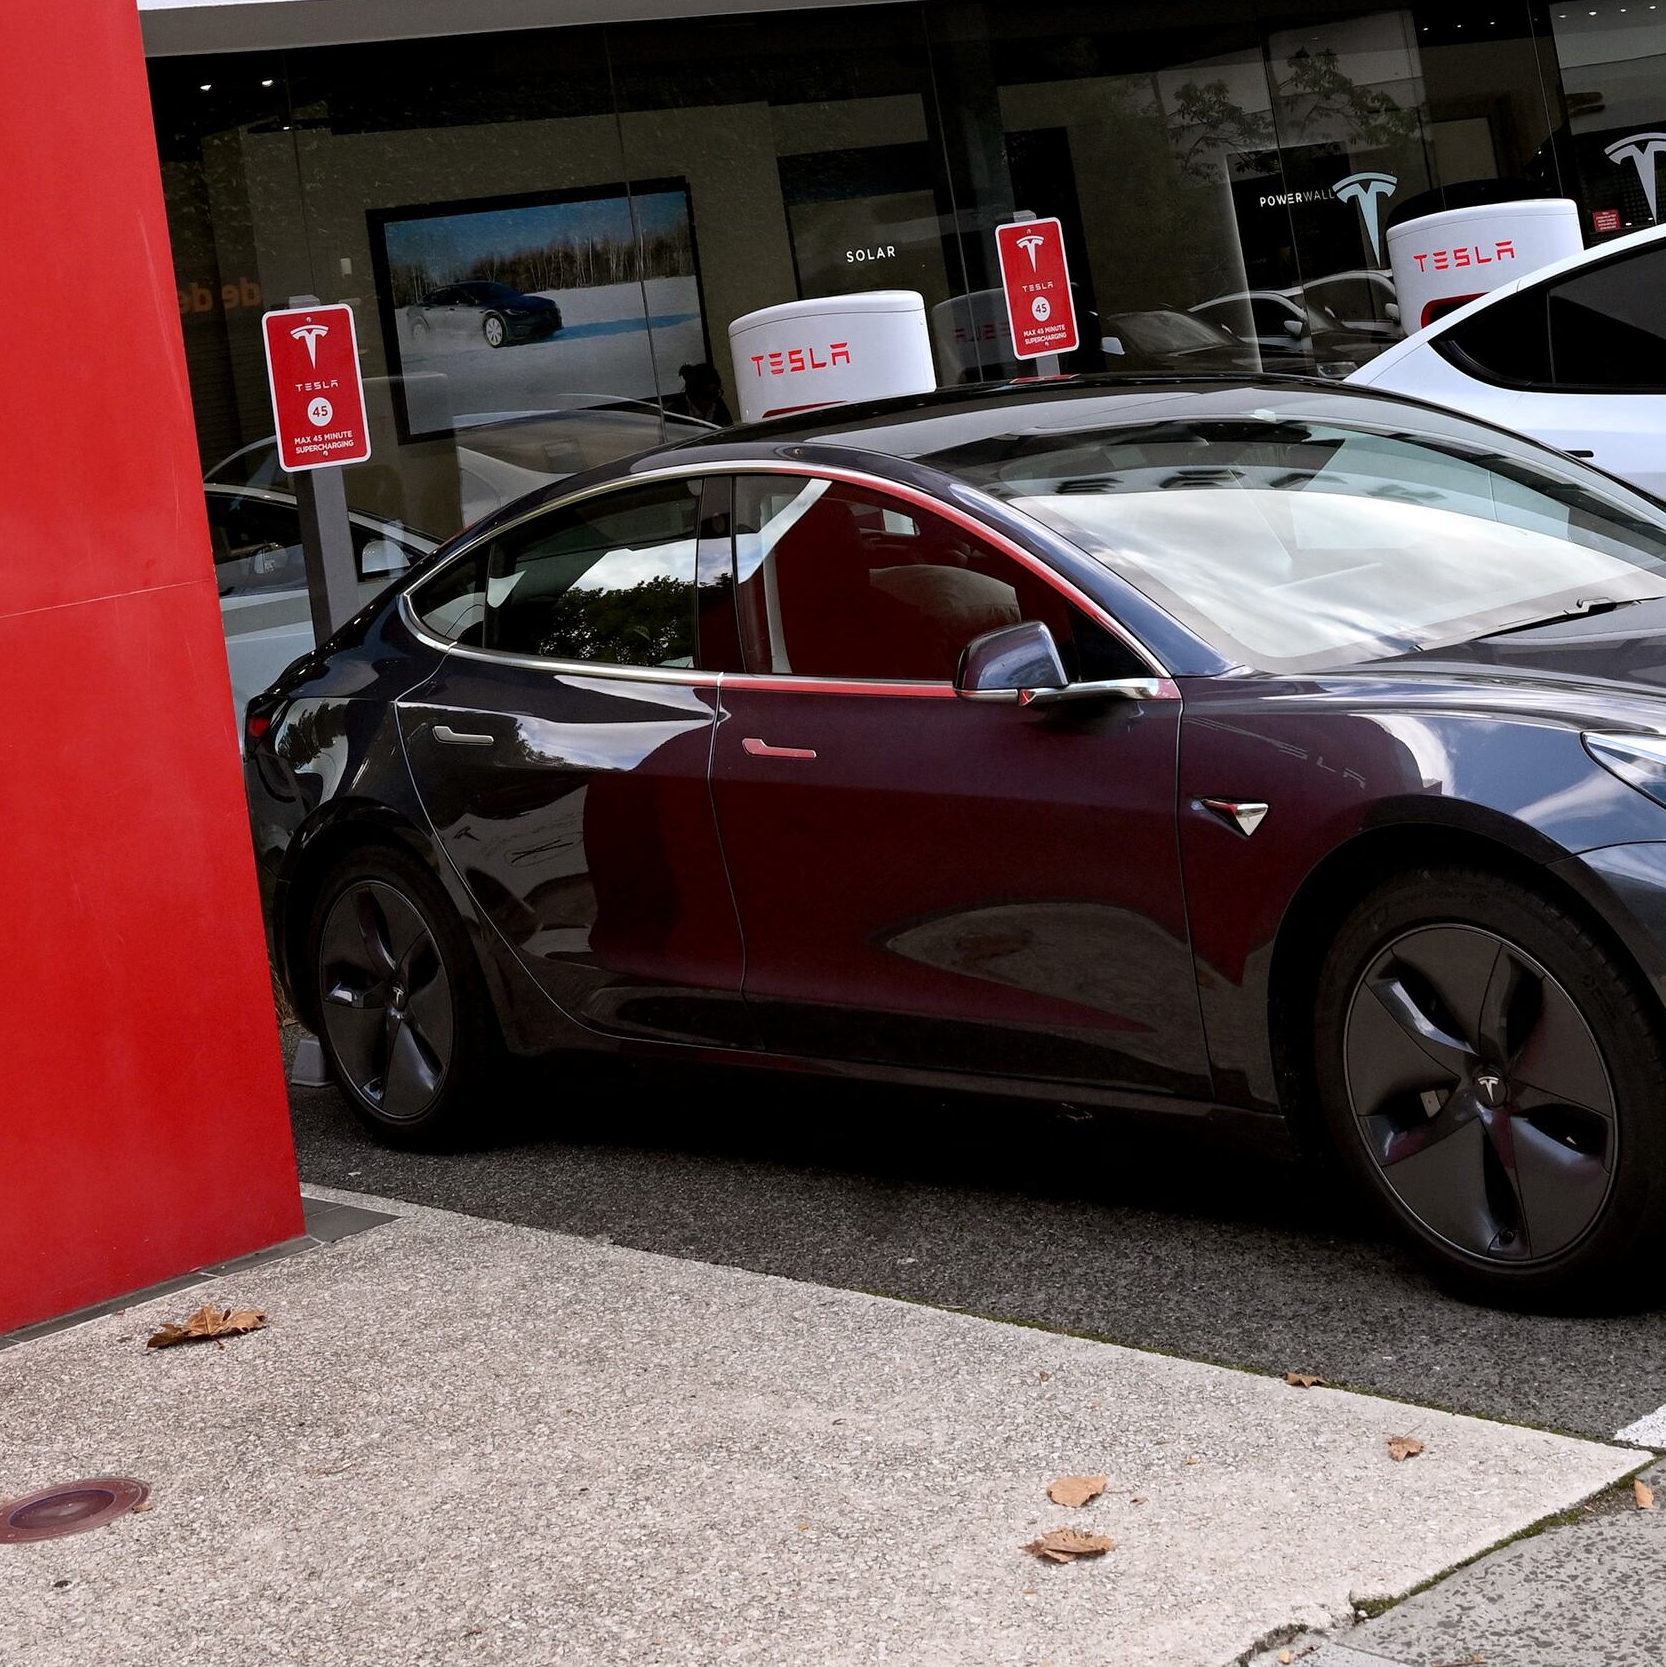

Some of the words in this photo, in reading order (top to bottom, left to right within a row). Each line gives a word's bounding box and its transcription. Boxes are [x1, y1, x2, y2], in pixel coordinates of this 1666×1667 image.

[1259, 188, 1335, 208] POWERWALL
[846, 245, 896, 263] SOLAR
[1413, 241, 1515, 272] TESLA
[1022, 281, 1053, 292] TESLA
[1036, 303, 1047, 313] 45
[751, 342, 851, 377] TESLA
[295, 380, 338, 392] TESLA
[313, 405, 328, 417] 45
[294, 436, 311, 445] MAX
[313, 434, 322, 442] 45
[324, 430, 353, 440] MINUTE
[295, 439, 354, 454] SUPERCHARGING
